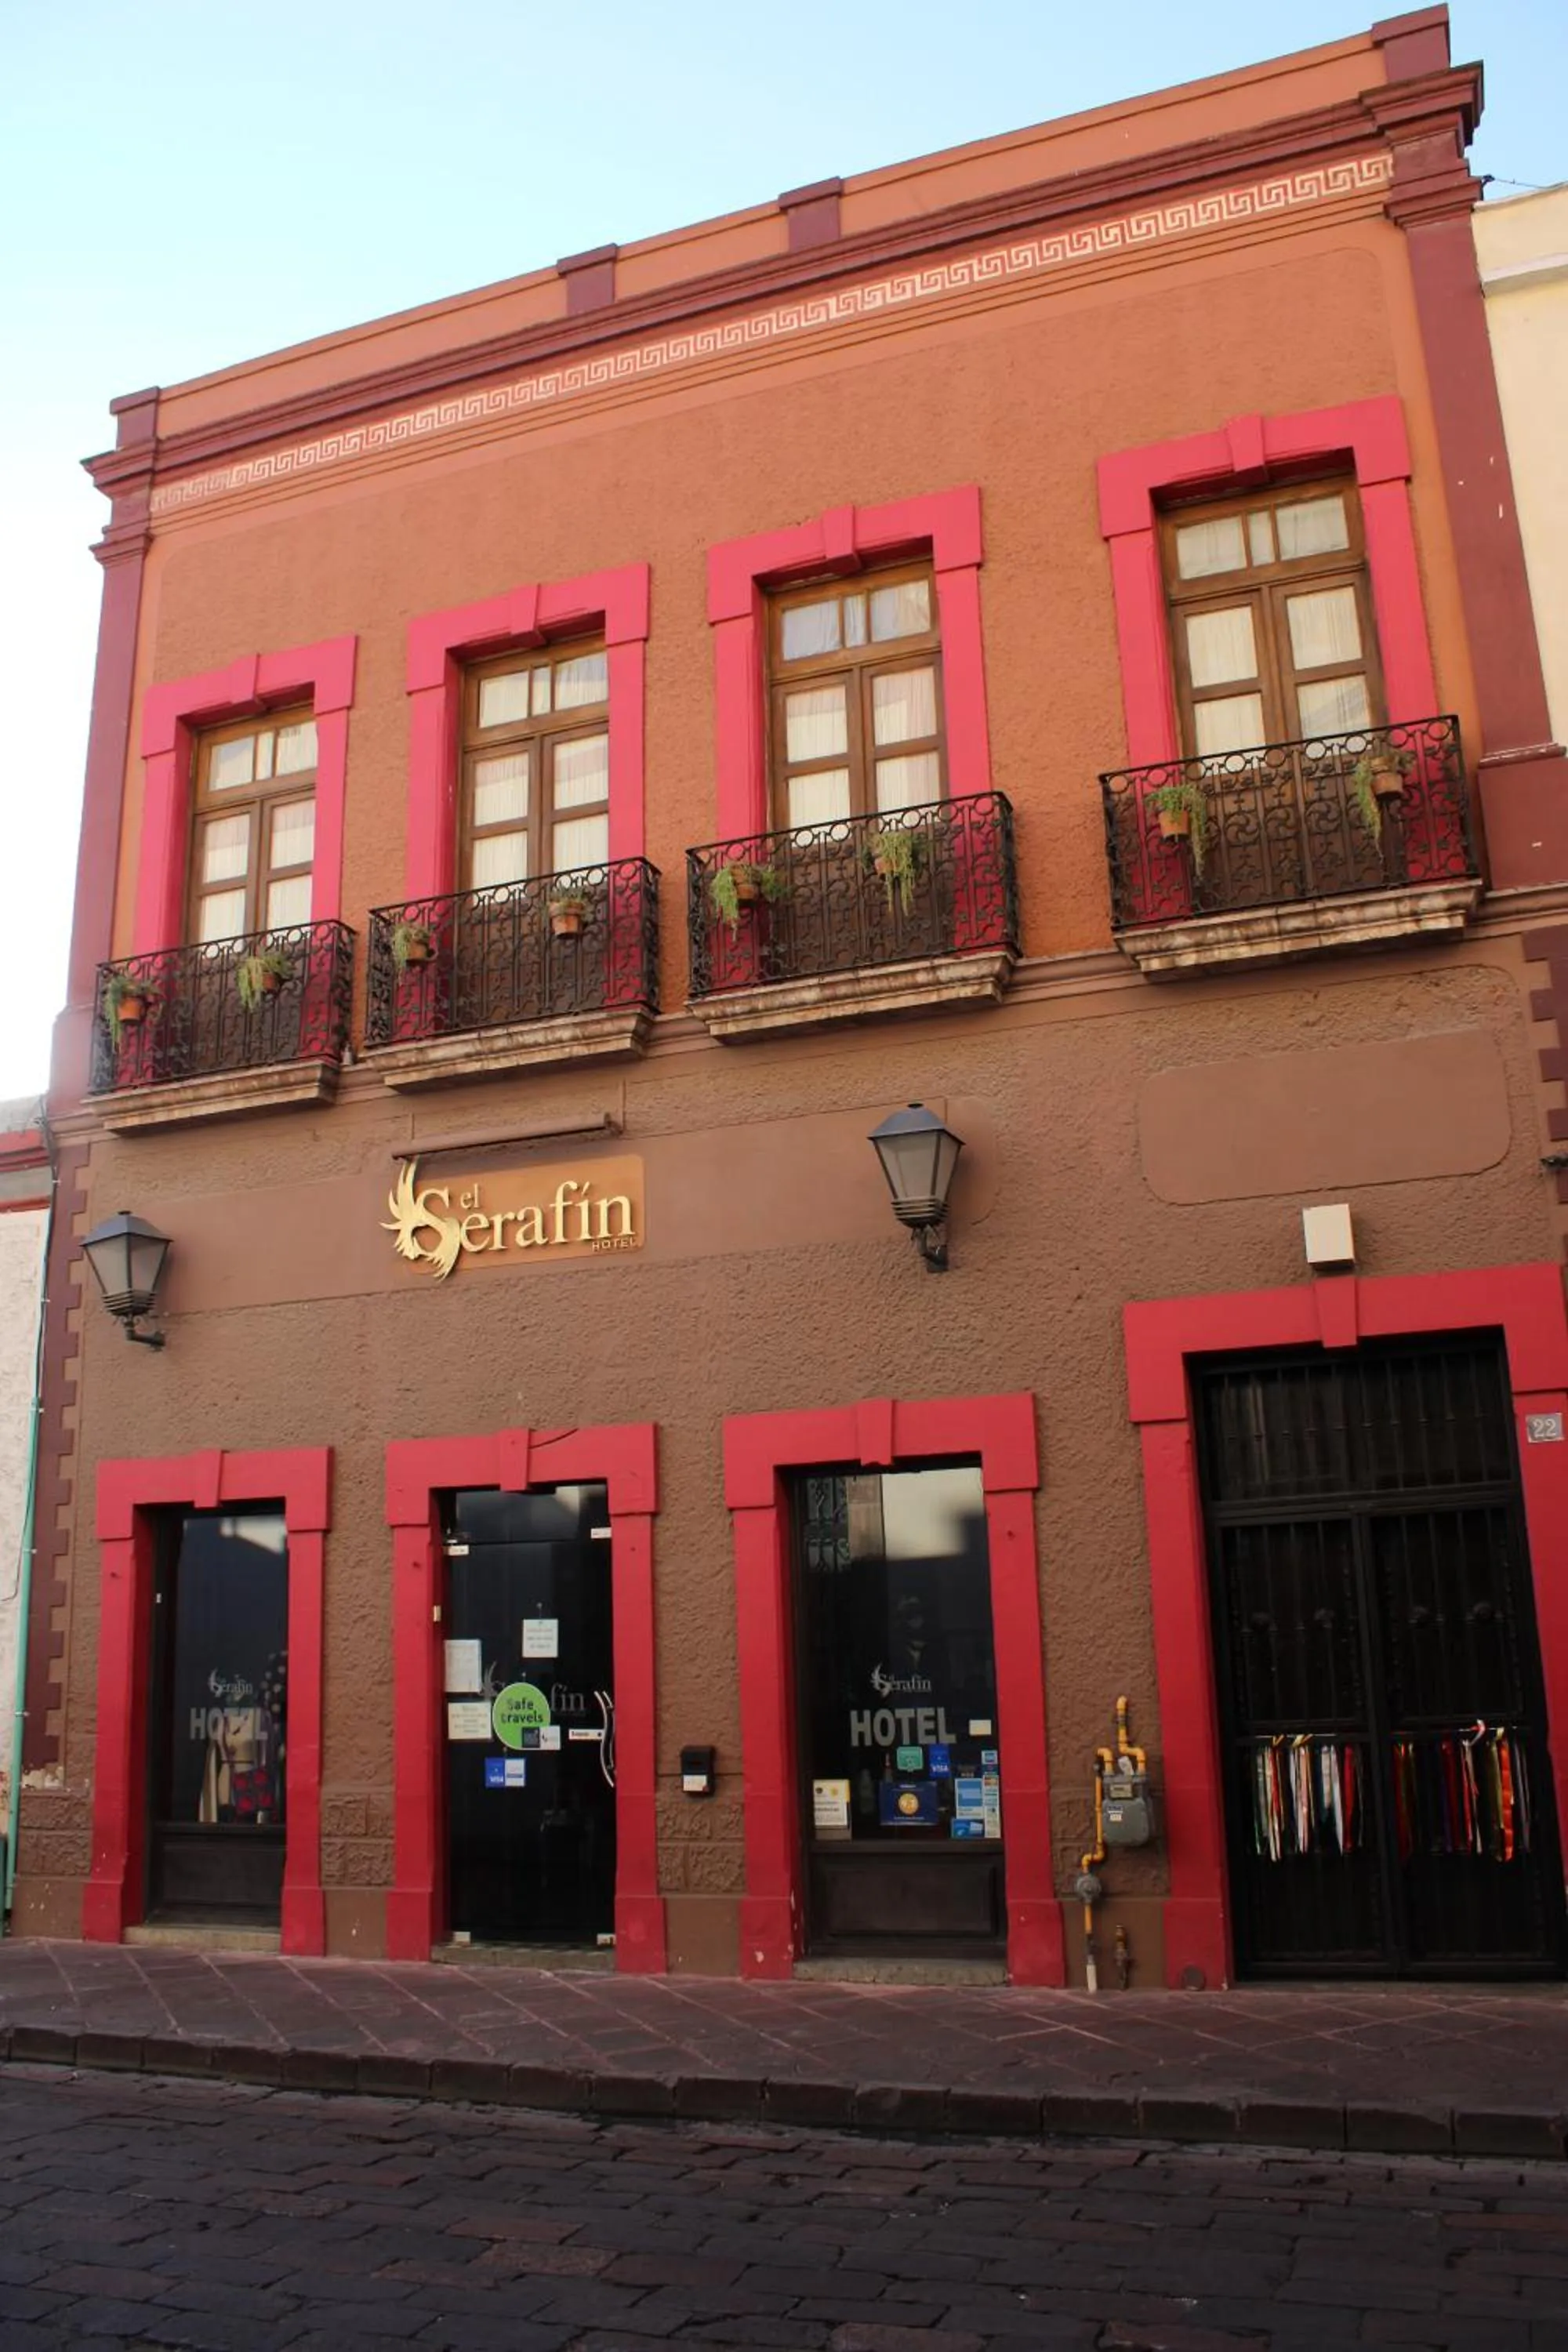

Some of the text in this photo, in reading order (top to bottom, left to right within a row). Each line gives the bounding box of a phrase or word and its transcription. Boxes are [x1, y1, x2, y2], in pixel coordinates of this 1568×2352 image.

[459, 1182, 480, 1210] el
[592, 1237, 636, 1251] HOTEL
[1532, 1417, 1557, 1438] 22
[506, 1697, 534, 1710] Safe
[500, 1710, 544, 1724] travels
[850, 1707, 957, 1747] HOTEL
